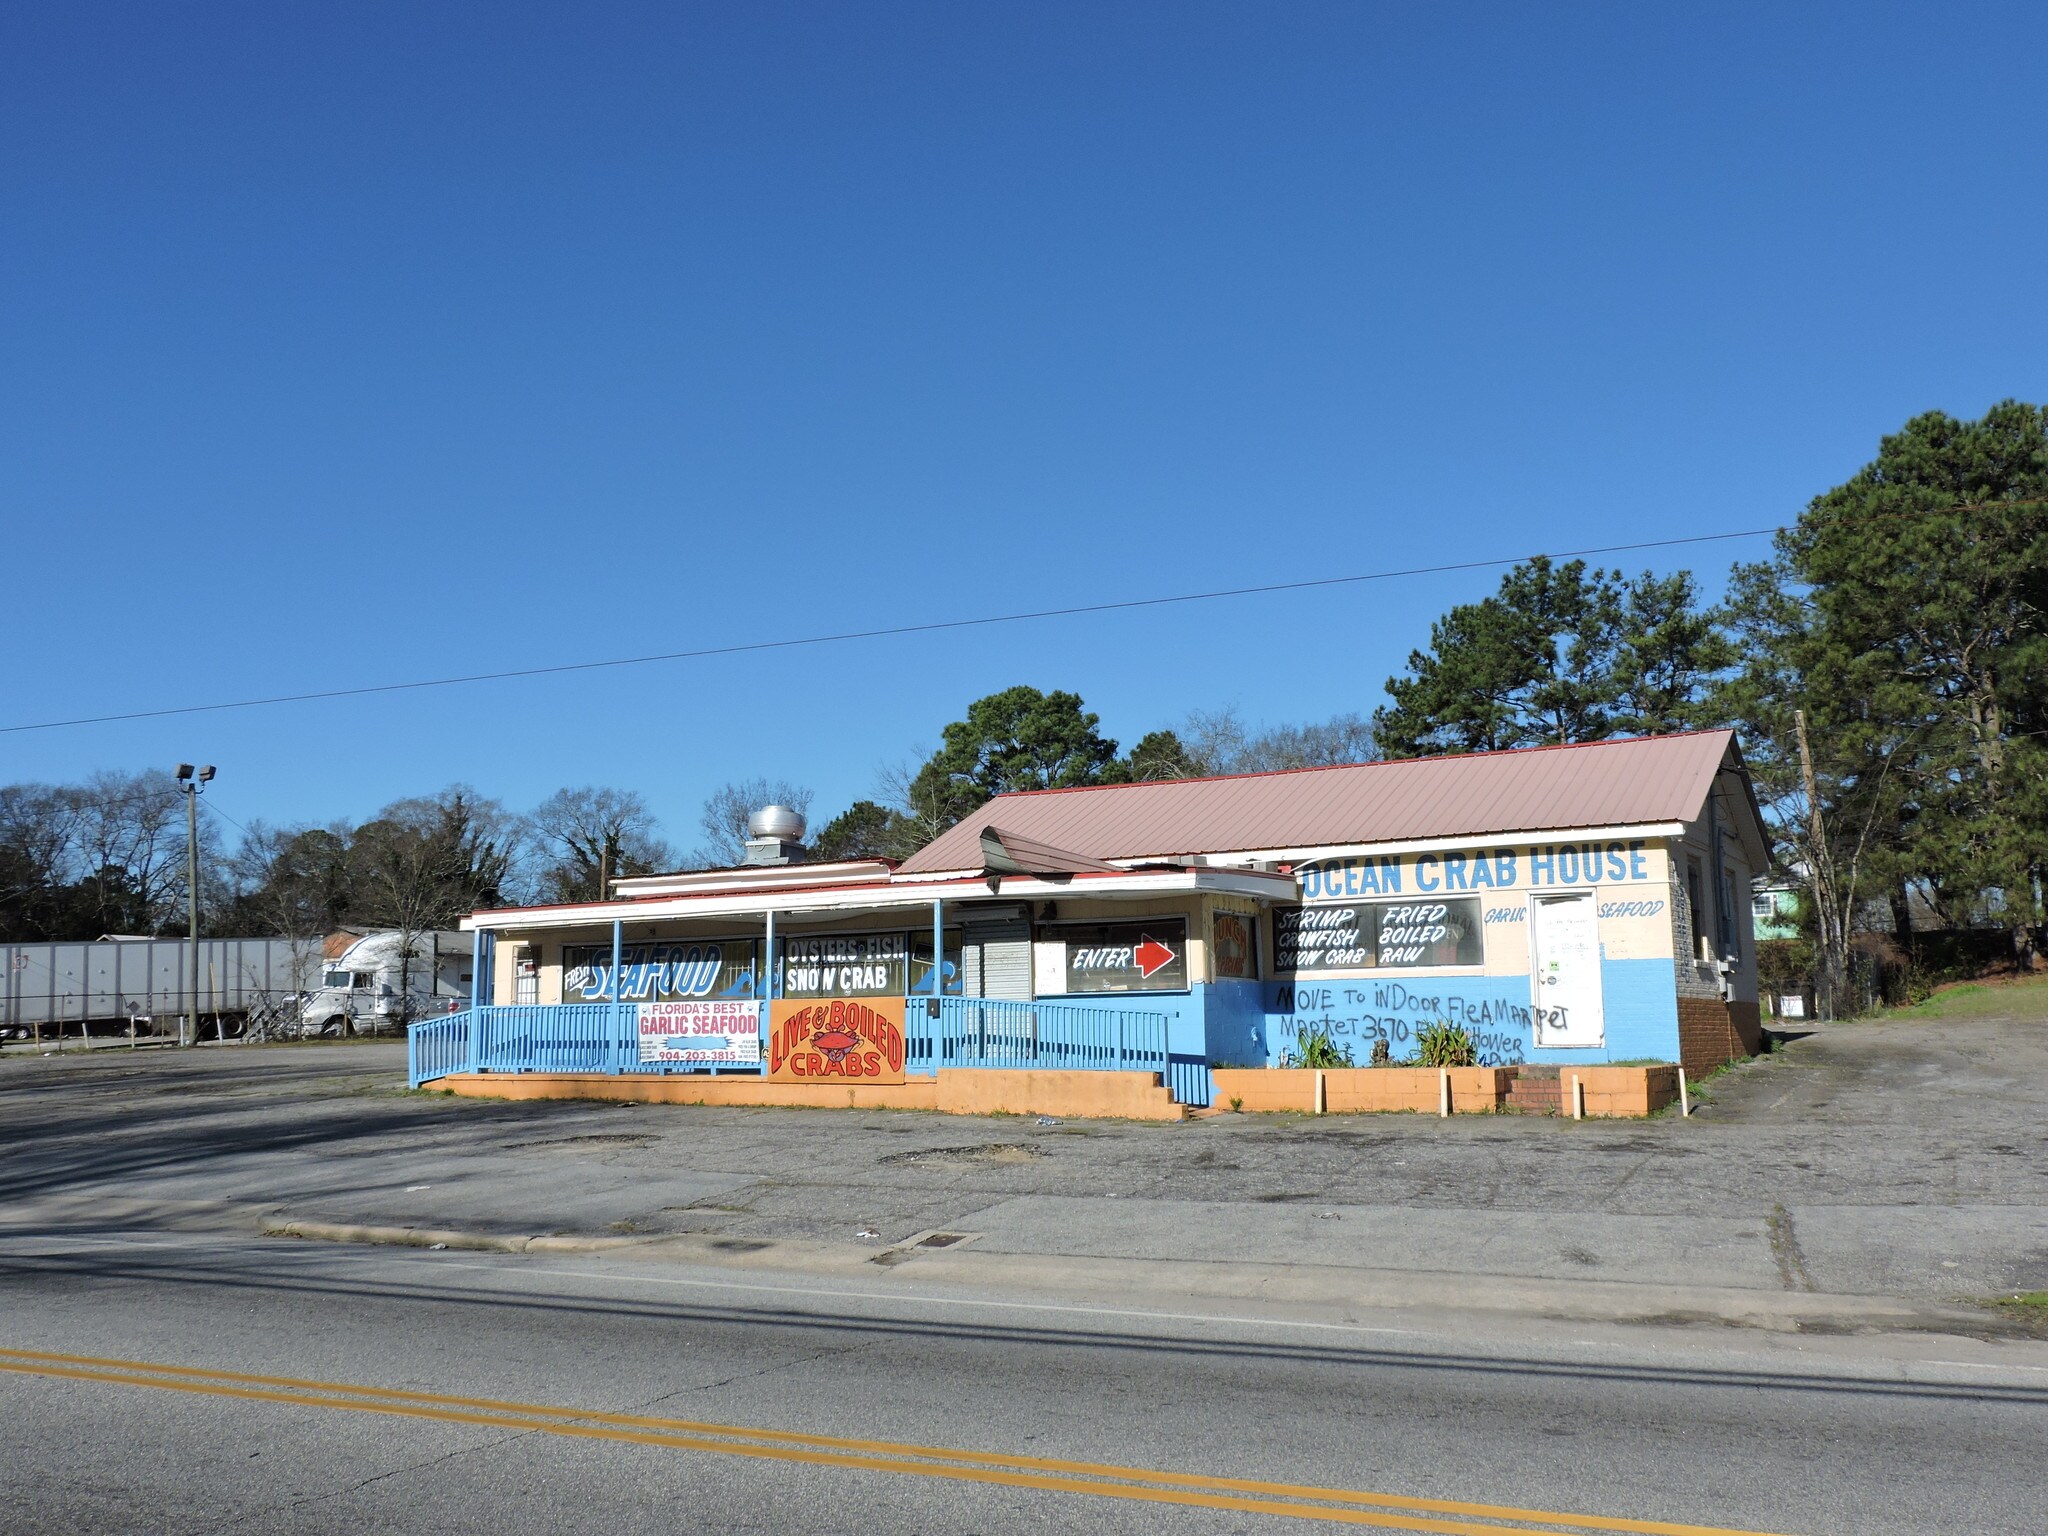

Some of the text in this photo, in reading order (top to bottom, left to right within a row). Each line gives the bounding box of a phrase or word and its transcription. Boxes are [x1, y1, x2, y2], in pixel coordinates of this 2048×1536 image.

[1302, 841, 1648, 898] OCEAN CRAB HOUSE
[1278, 909, 1355, 929] SHRIMP
[1382, 904, 1447, 925] FRIED
[1484, 907, 1527, 924] GARLIC
[1599, 900, 1664, 918] SEAFOOD
[1279, 929, 1360, 948] CRAWFISH
[1379, 926, 1446, 945] BOILED
[788, 936, 904, 963] OYSTERS FISH
[1072, 947, 1131, 970] ENTER
[1276, 948, 1366, 967] SNOW CRAB
[1379, 946, 1425, 963] RAW
[564, 959, 590, 990] FRESH
[580, 945, 722, 999] SEAFOOD
[787, 965, 887, 991] SNOW CRAB
[652, 1003, 744, 1015] FLORIDA'S BEST
[1277, 986, 1335, 1011] MOVE
[640, 1014, 757, 1035] GARLIC SEAFOOD
[1362, 1015, 1409, 1042] 3670
[771, 1001, 902, 1074] LIVE & BOILED
[659, 1051, 736, 1060] 904-203-3815
[790, 1051, 881, 1077] CRABS
